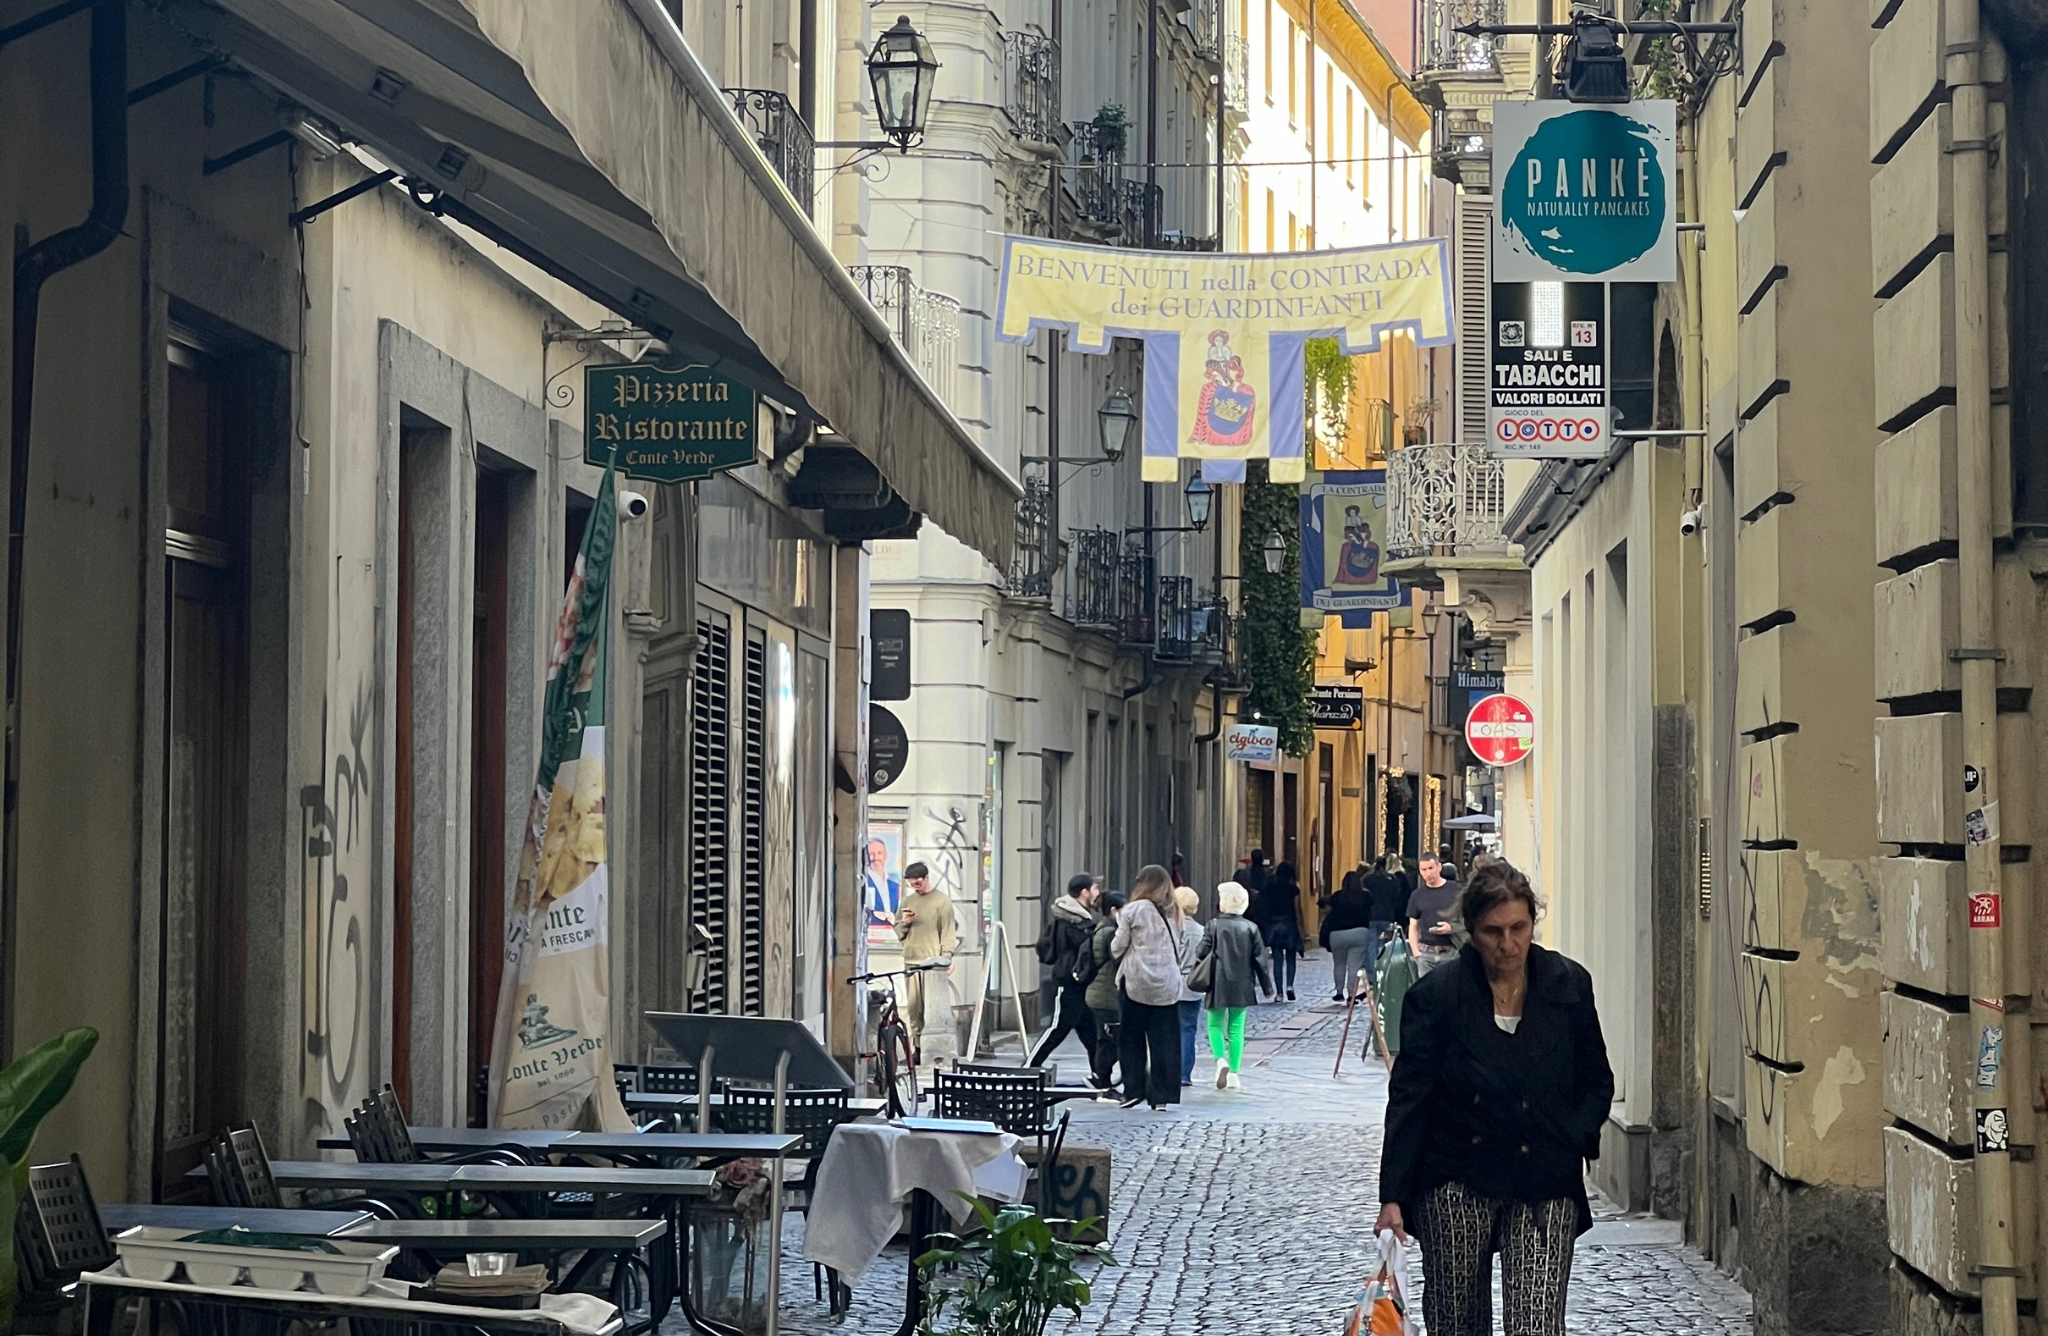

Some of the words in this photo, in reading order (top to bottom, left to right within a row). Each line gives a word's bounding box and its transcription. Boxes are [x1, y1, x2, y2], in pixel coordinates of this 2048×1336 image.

[1527, 147, 1650, 198] PANKÈ
[1527, 201, 1589, 216] NATURALLY
[1594, 201, 1650, 216] PANCAKES
[1015, 254, 1190, 290] BENVENUTI
[1201, 265, 1257, 291] nella
[1270, 257, 1433, 291] CONTRADA
[1111, 288, 1149, 316] dei
[1159, 290, 1384, 319] GUARDINFANTI
[1576, 330, 1592, 343] 13
[1523, 350, 1558, 362] SALI
[1563, 350, 1573, 361] E
[1495, 364, 1601, 386] TABACCHI
[612, 374, 729, 408] Pizzeria
[1496, 393, 1543, 405] VALORI
[1547, 393, 1601, 405] BOLLATI
[593, 413, 748, 441] Ristorante
[1499, 420, 1598, 440] LOTTO
[626, 450, 668, 464] Conte
[672, 449, 715, 465] Verde
[1322, 485, 1334, 493] LA
[1316, 598, 1331, 607] DEI
[1333, 597, 1398, 607] GUARDINFANTI
[1481, 723, 1517, 737] OAS
[549, 929, 592, 947] FRESCA
[506, 1059, 549, 1083] onte
[551, 1038, 602, 1066] Verde
